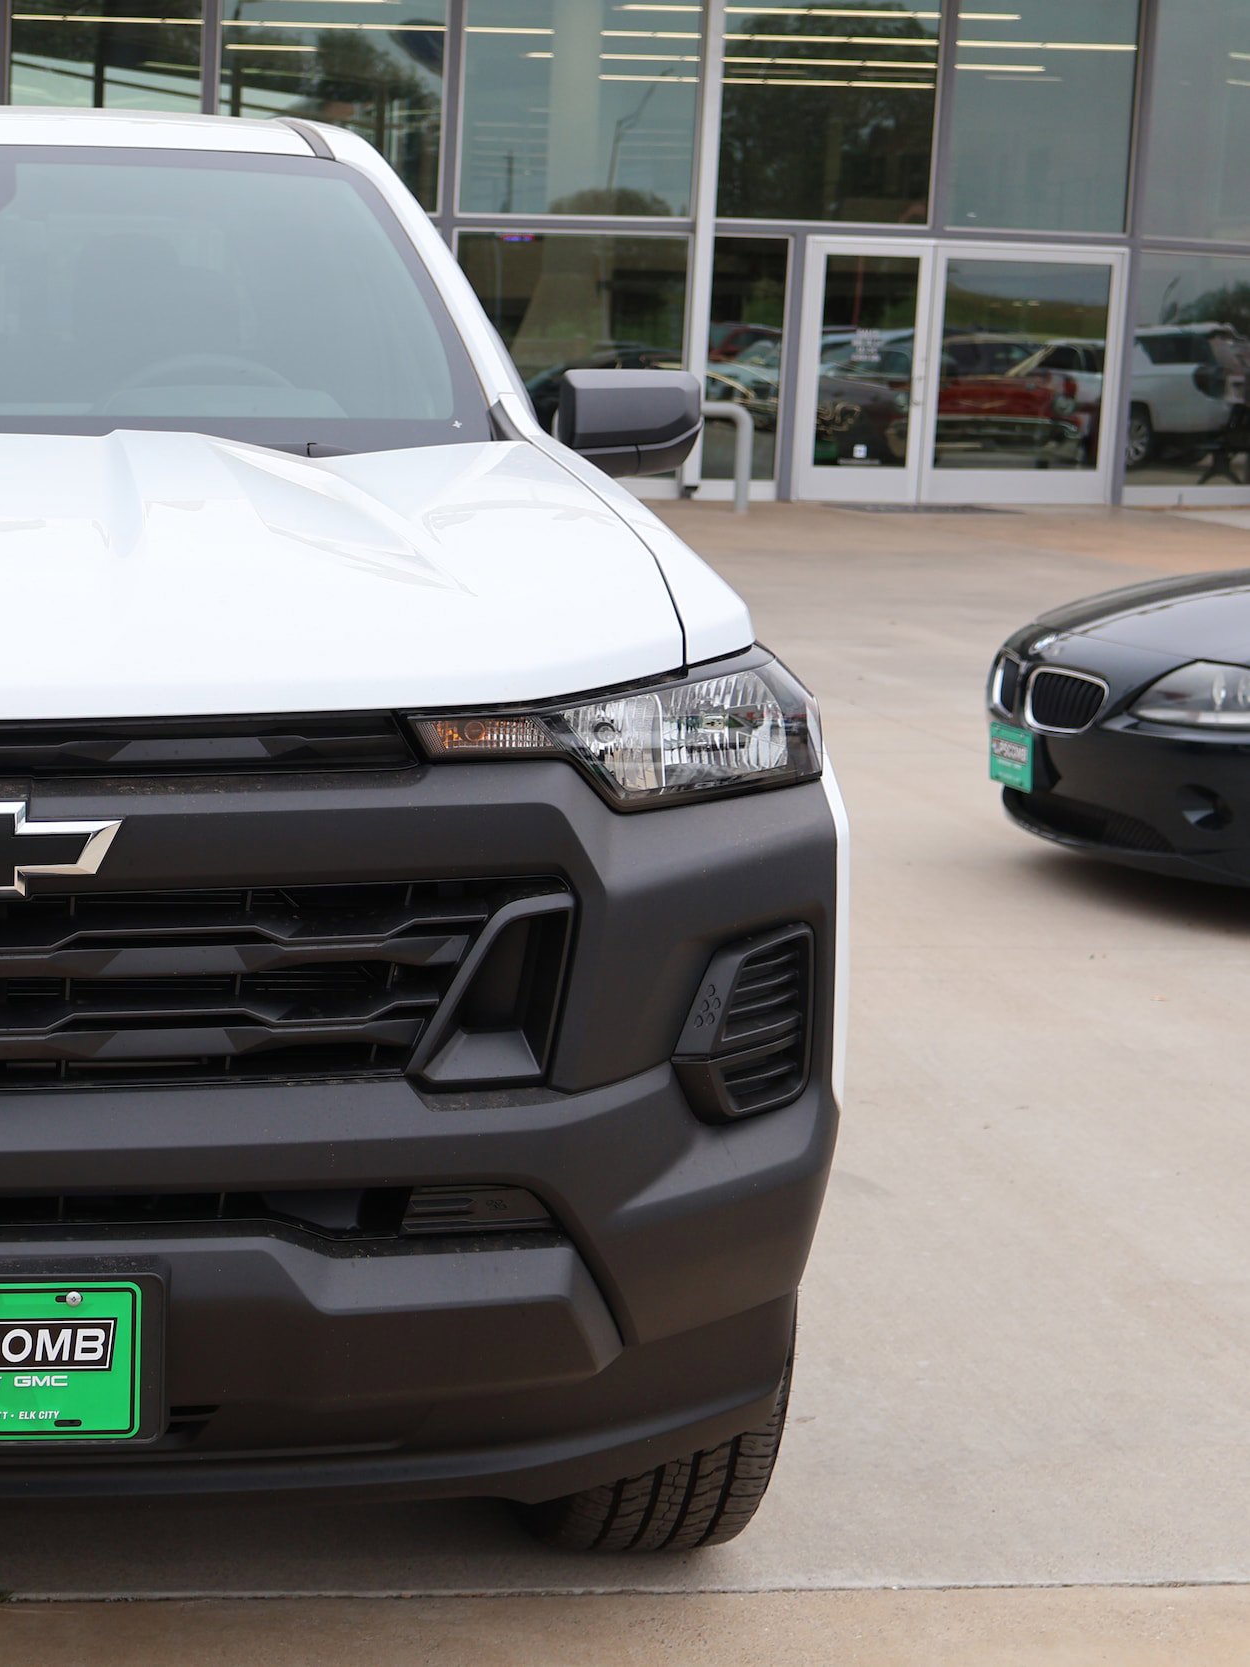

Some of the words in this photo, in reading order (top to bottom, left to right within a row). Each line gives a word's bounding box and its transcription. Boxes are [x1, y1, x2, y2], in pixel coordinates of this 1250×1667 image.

[13, 1375, 68, 1388] GMC
[18, 1410, 36, 1420] ELK
[37, 1410, 60, 1420] CITY
